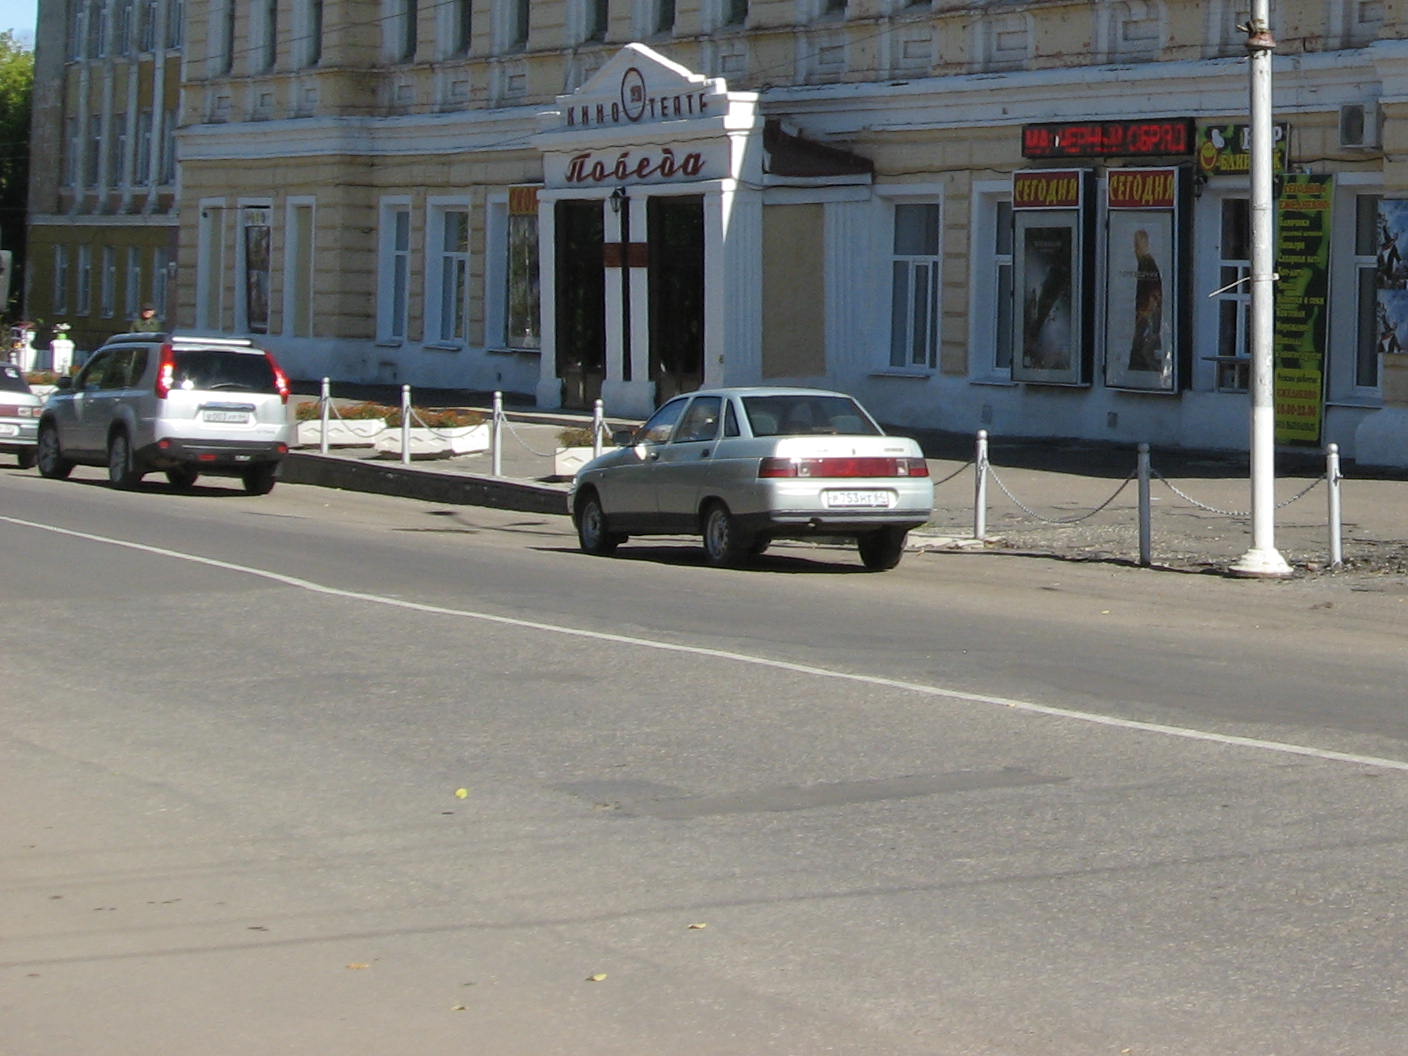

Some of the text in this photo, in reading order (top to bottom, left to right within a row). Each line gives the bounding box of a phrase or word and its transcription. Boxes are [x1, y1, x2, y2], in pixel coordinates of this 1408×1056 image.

[565, 147, 706, 183] Победа
[1014, 175, 1079, 205] СЕГОДНЯ
[1108, 173, 1176, 205] СЕГОДНЯ
